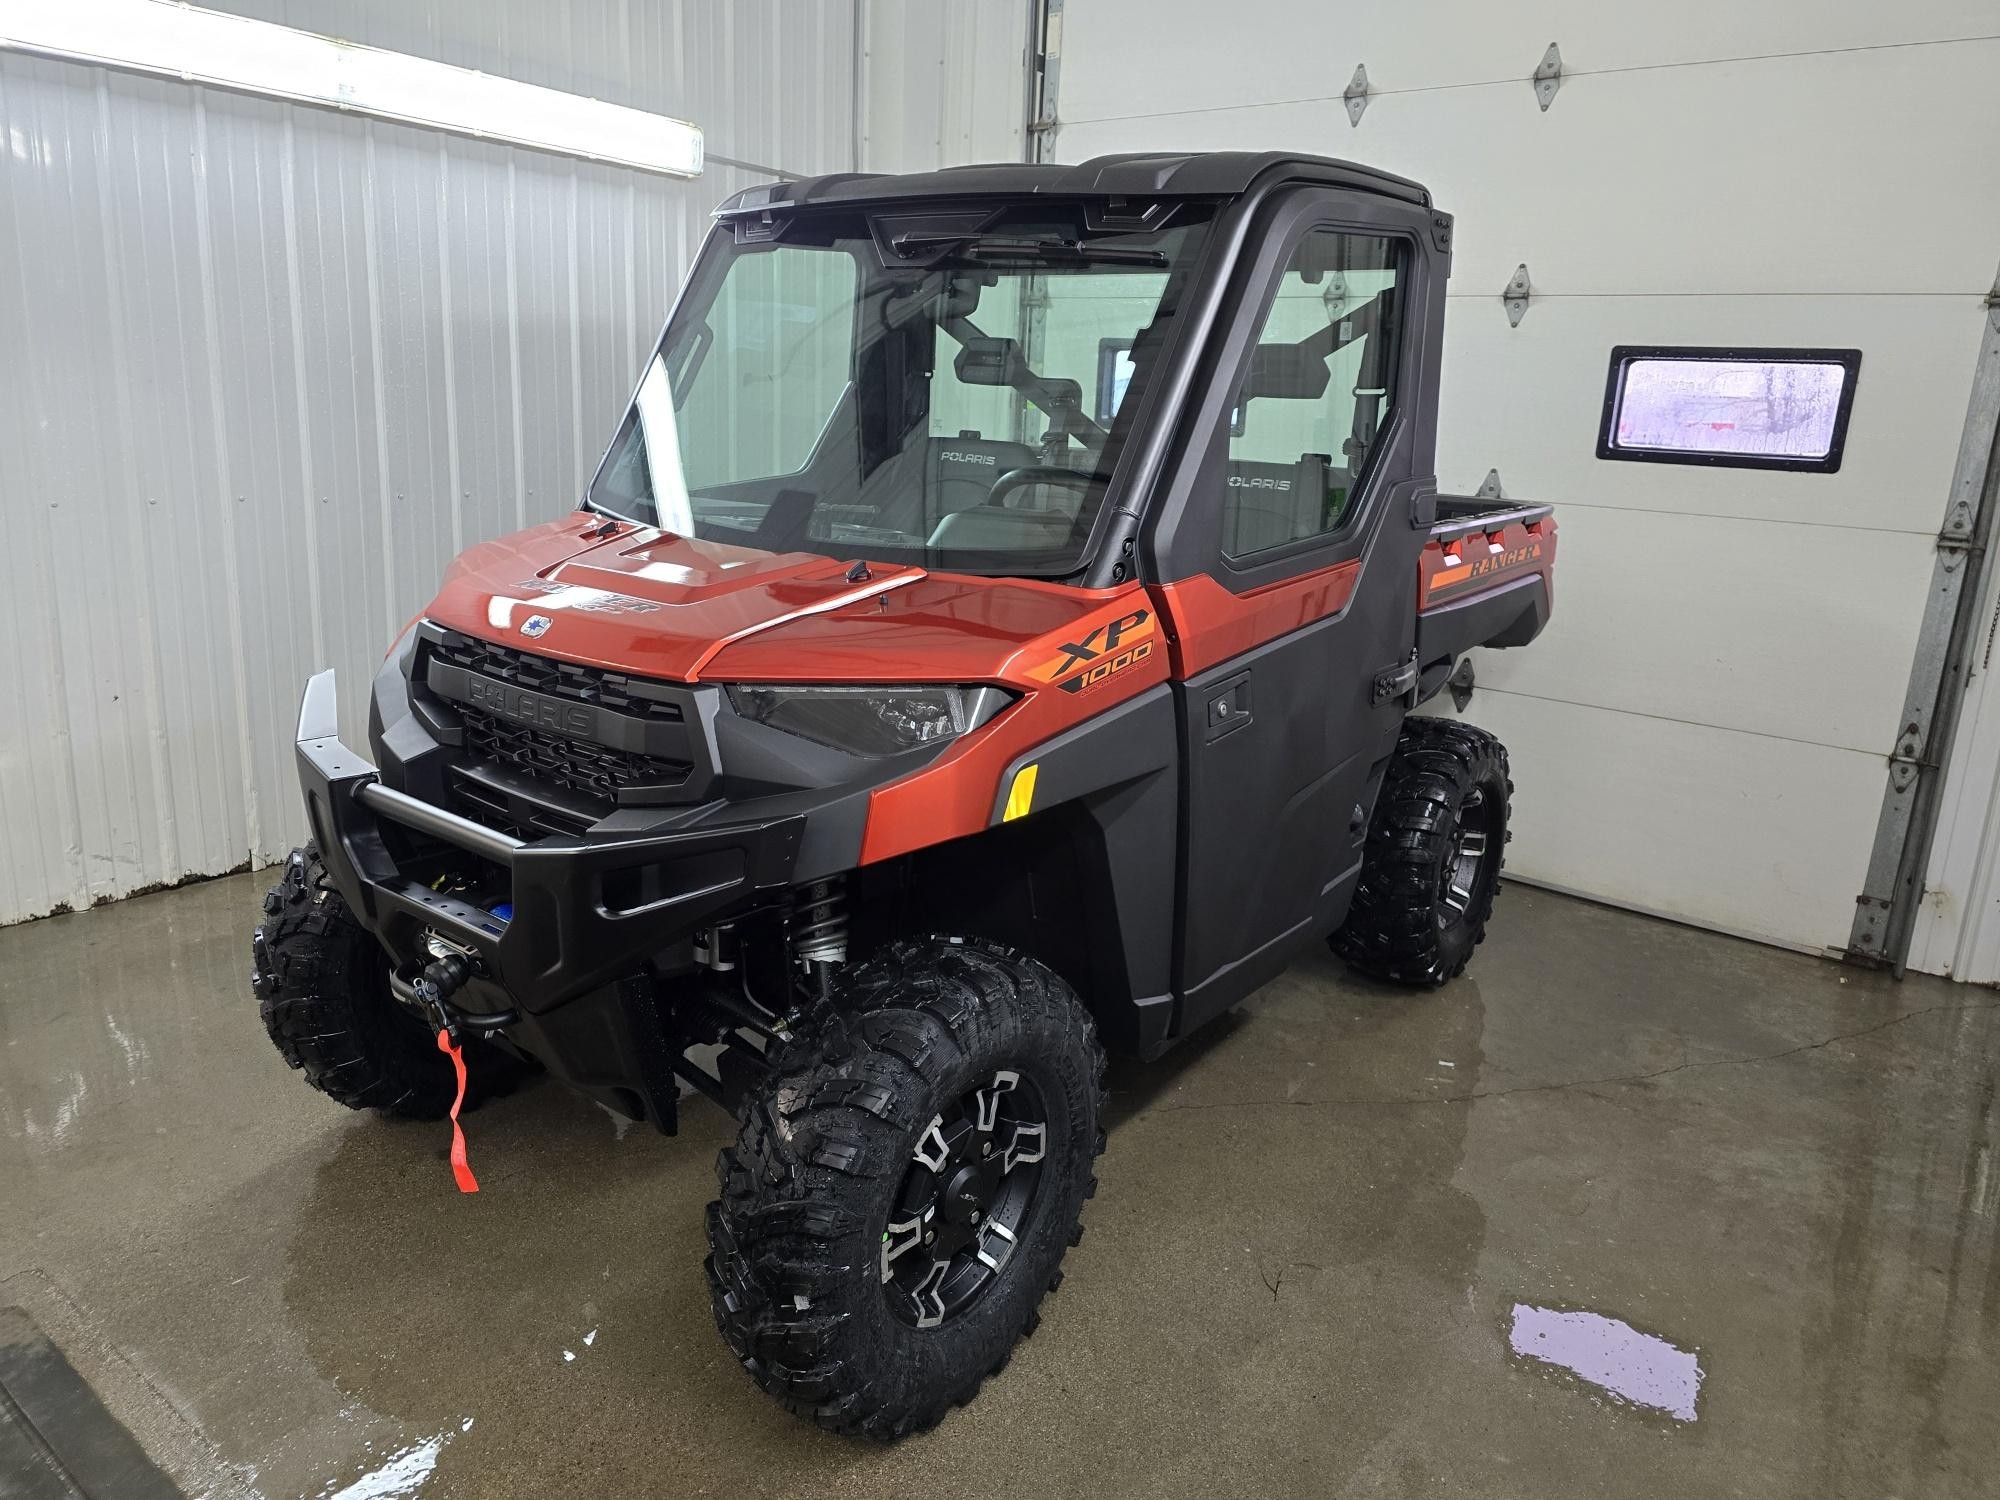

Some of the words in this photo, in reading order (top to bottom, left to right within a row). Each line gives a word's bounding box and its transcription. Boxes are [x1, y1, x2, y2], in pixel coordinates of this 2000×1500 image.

[941, 451, 996, 466] POLARIS
[1227, 476, 1291, 491] OLARIS
[1470, 543, 1536, 578] RANGER
[1049, 608, 1151, 680] XP
[1081, 641, 1153, 689] 1000
[469, 677, 592, 736] POLARIS
